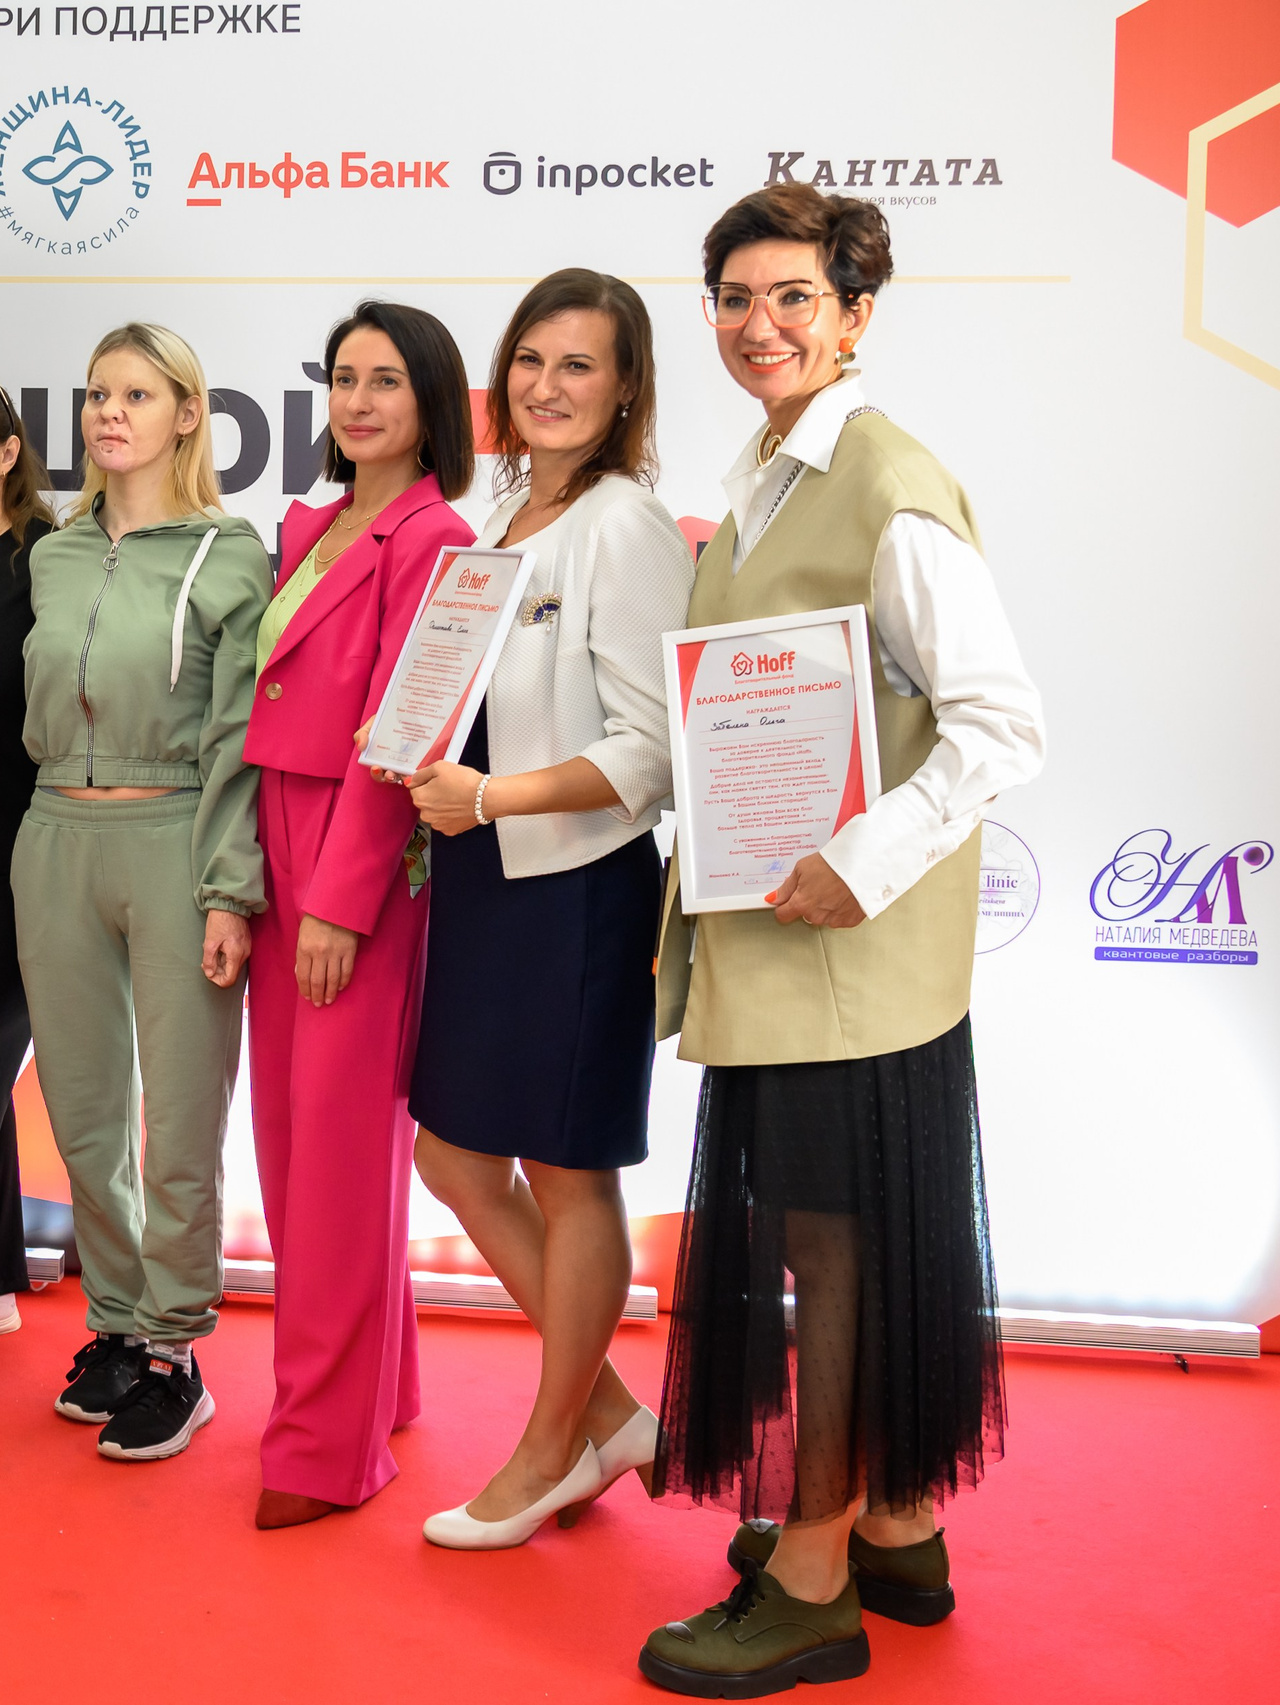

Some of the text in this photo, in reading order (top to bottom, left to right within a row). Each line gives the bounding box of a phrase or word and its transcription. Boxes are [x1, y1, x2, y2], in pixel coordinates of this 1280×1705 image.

[54, 4, 302, 42] ПОДДЕРЖКЕ
[187, 151, 450, 199] Альфа Банк
[536, 155, 714, 196] inpocket
[890, 195, 937, 209] вкусов
[696, 680, 842, 705] БЛАГОДАРСТВЕННОЕ ПИСЬМО
[745, 704, 791, 715] НАГРАЖДАЕТСЯ
[983, 875, 1018, 888] linic
[1095, 925, 1258, 948] НАТАЛИЯ МЕДВЕДЕВА
[1103, 950, 1249, 963] квантовые разборы
